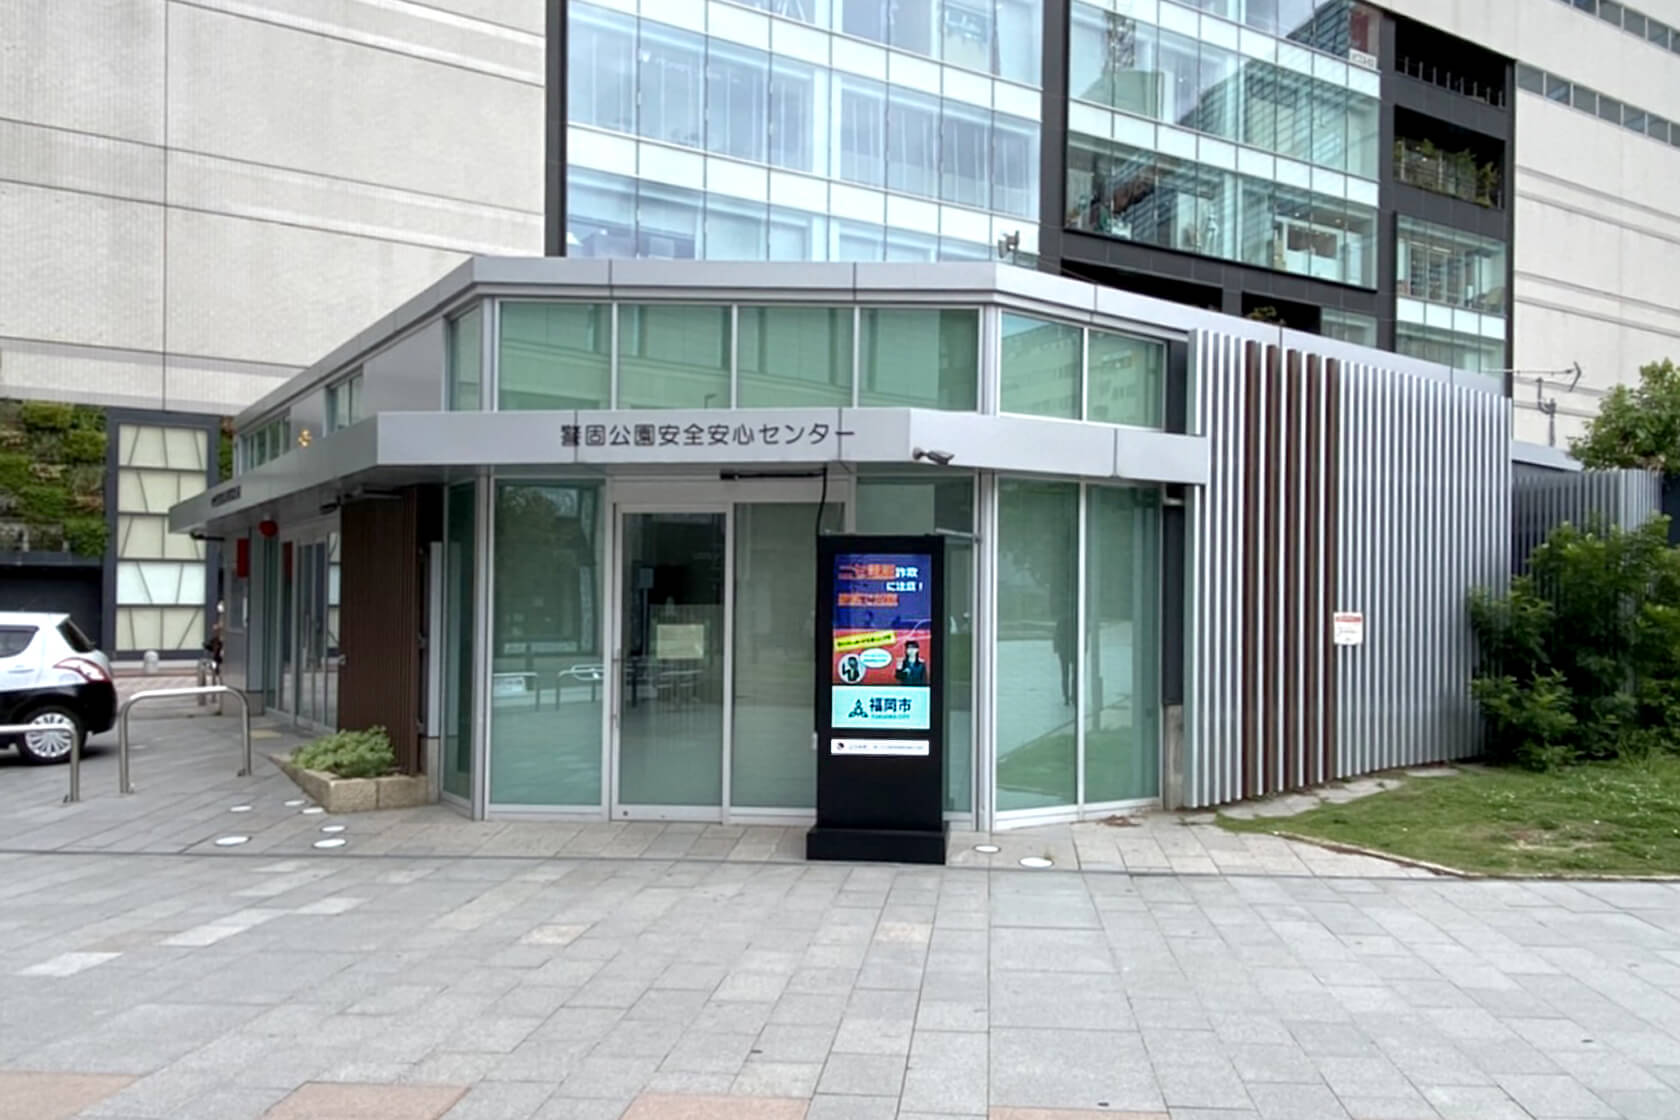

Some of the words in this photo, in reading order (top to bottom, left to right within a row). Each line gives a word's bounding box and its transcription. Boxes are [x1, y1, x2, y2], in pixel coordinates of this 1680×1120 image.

[560, 423, 856, 447] 警固公園安全安心センター
[869, 697, 912, 713] 福岡市
